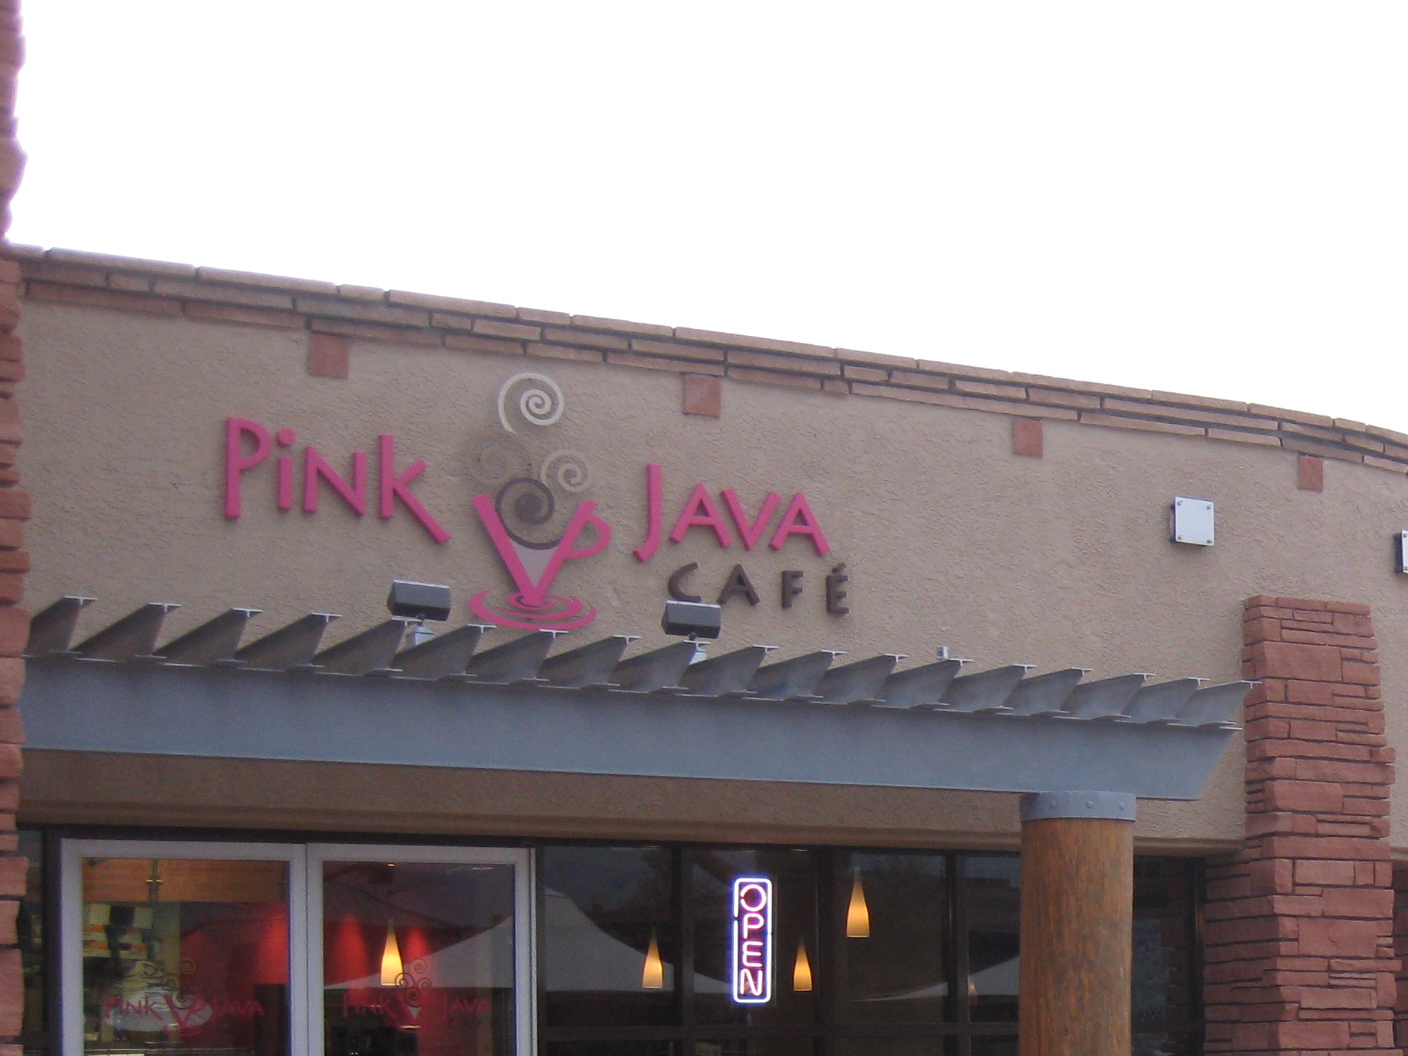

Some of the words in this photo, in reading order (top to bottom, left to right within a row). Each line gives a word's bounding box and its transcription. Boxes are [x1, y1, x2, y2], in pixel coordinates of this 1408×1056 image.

[633, 463, 831, 562] JAVA
[667, 561, 850, 615] CAFÉ
[740, 883, 767, 996] OPEN
